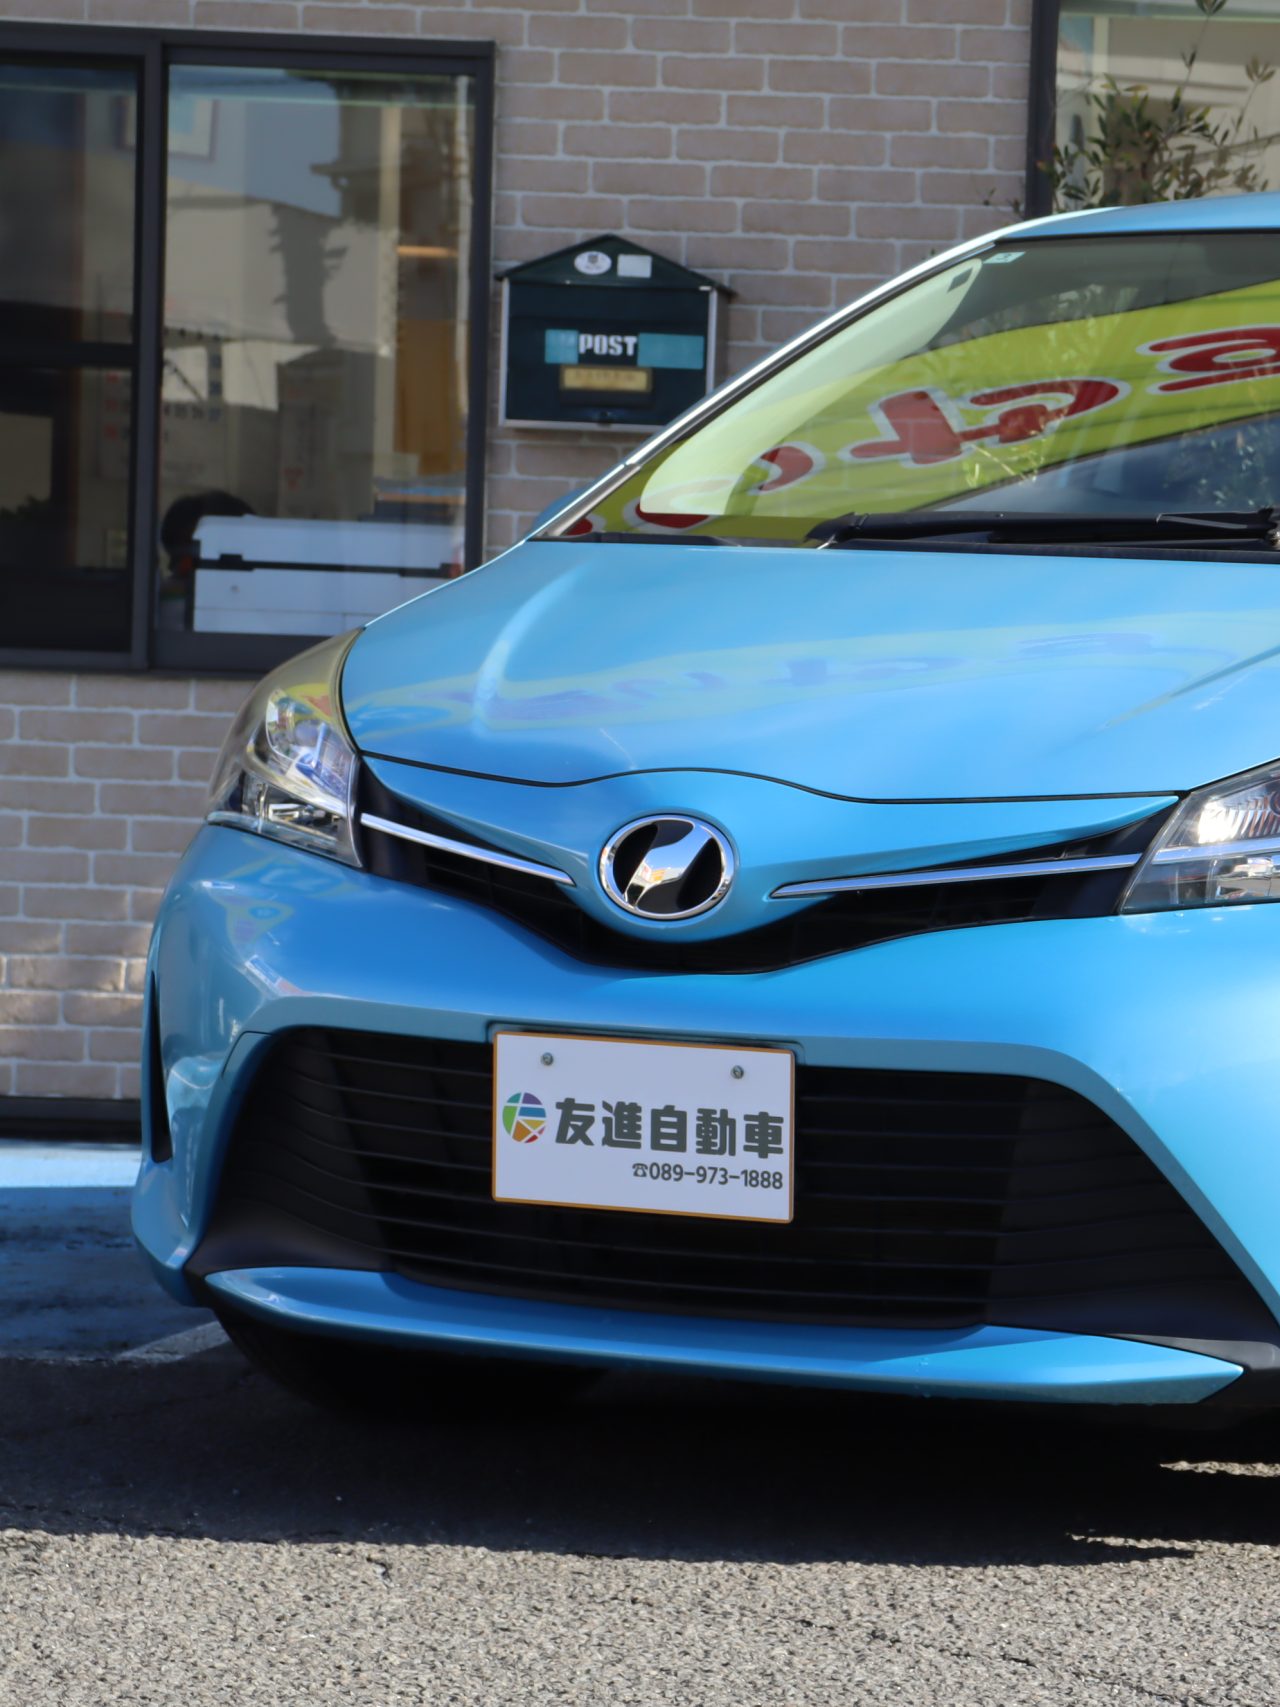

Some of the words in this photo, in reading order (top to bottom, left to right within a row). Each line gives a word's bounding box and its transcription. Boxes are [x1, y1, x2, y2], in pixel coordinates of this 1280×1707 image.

[578, 333, 638, 357] POST
[555, 1097, 785, 1160] 友進自動車
[648, 1163, 784, 1190] 089-973-1888
